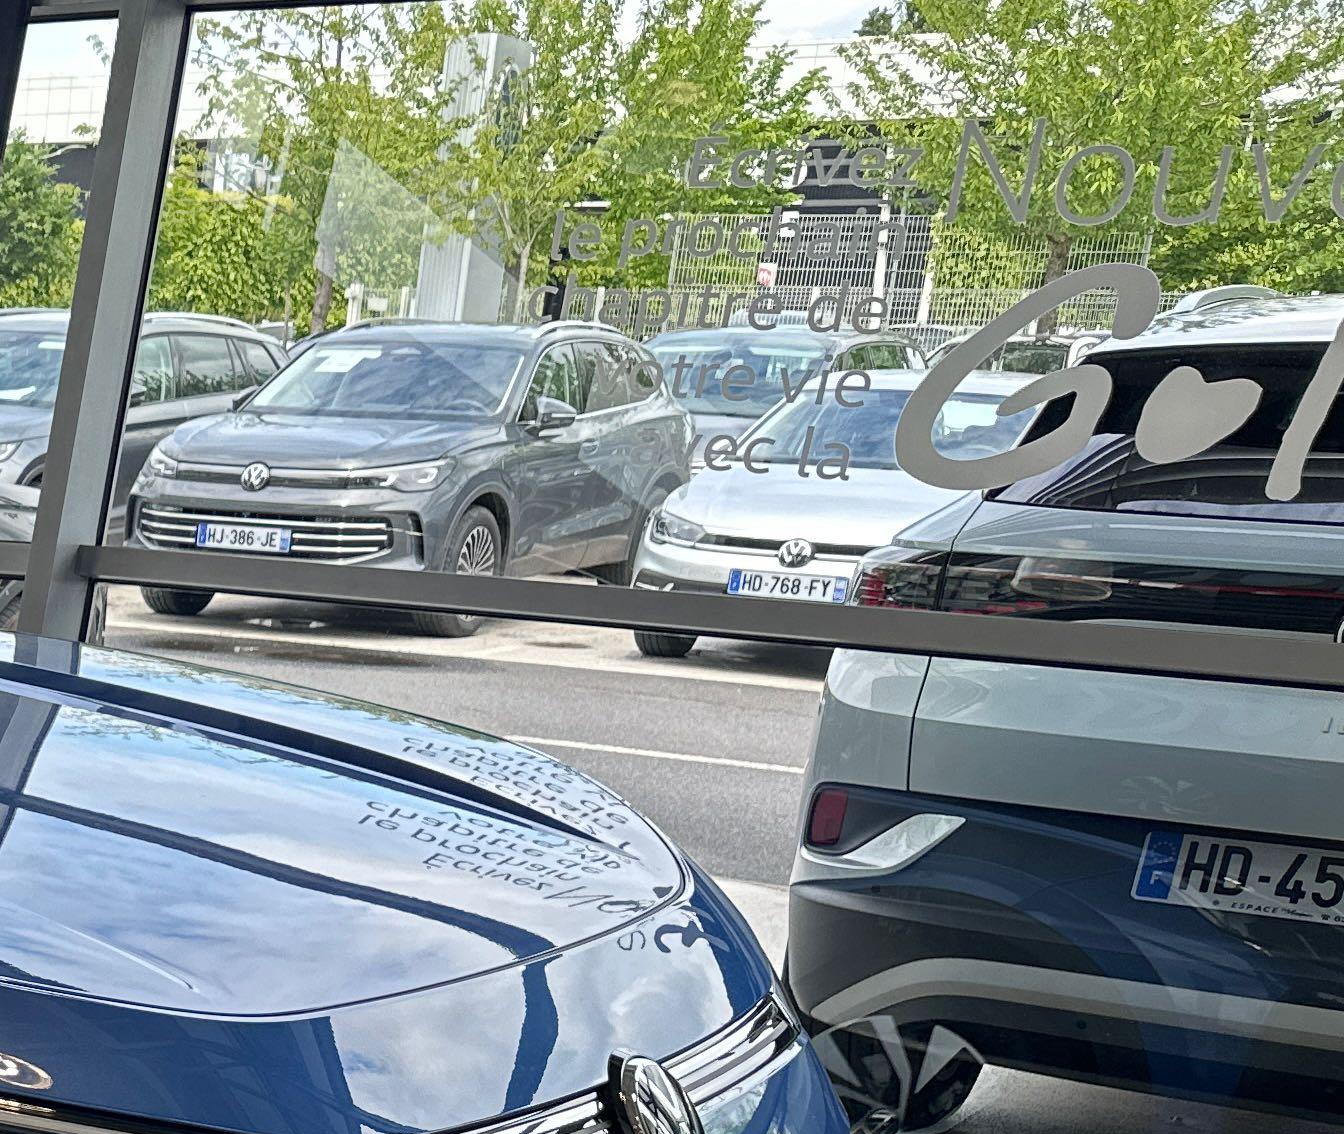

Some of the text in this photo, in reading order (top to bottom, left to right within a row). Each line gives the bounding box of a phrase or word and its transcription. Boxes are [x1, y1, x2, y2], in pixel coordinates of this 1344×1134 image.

[944, 116, 1344, 227] Nouv
[551, 205, 908, 267] le prochain
[527, 272, 890, 336] chapitre de
[596, 354, 872, 408] votre vie
[797, 425, 850, 482] la
[208, 527, 278, 548] HJ-386-JE
[741, 573, 831, 598] HD-768-FY
[1230, 900, 1279, 914] ESPACE
